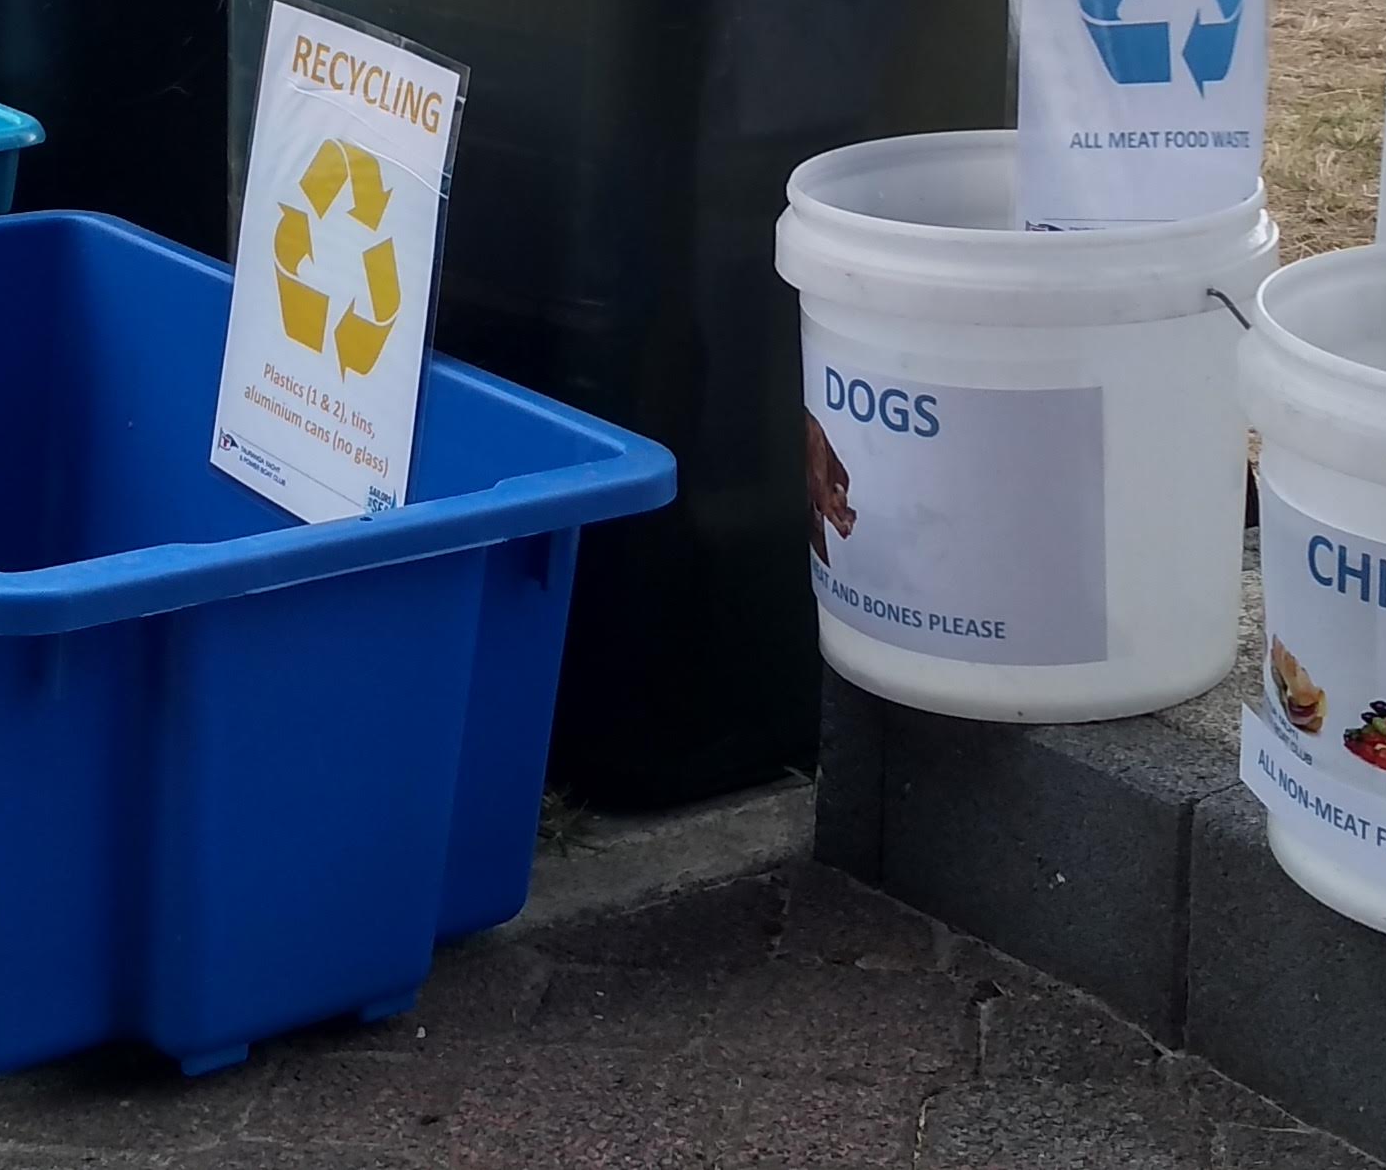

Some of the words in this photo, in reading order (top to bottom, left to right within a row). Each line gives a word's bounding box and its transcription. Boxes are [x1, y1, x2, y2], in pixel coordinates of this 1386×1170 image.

[292, 35, 443, 134] RECYCLING
[1069, 132, 1103, 149] ALL
[1108, 131, 1160, 149] MEAT
[1164, 131, 1209, 148] FOOD
[1213, 131, 1250, 148] WASTE
[244, 385, 303, 428] aluminium
[305, 419, 330, 443] cans
[333, 430, 353, 455] (no
[354, 445, 389, 478] glass)
[264, 363, 304, 398] Plastics
[306, 384, 317, 406] (1
[320, 394, 330, 413] &
[352, 411, 376, 439] tins,
[825, 366, 940, 438] DOGS
[812, 562, 830, 590] EAT
[831, 579, 859, 608] AND
[863, 595, 922, 628] BONES
[929, 613, 1006, 639] PLEASE
[1258, 749, 1276, 781] ALL
[1278, 768, 1371, 840] NON-MEAT
